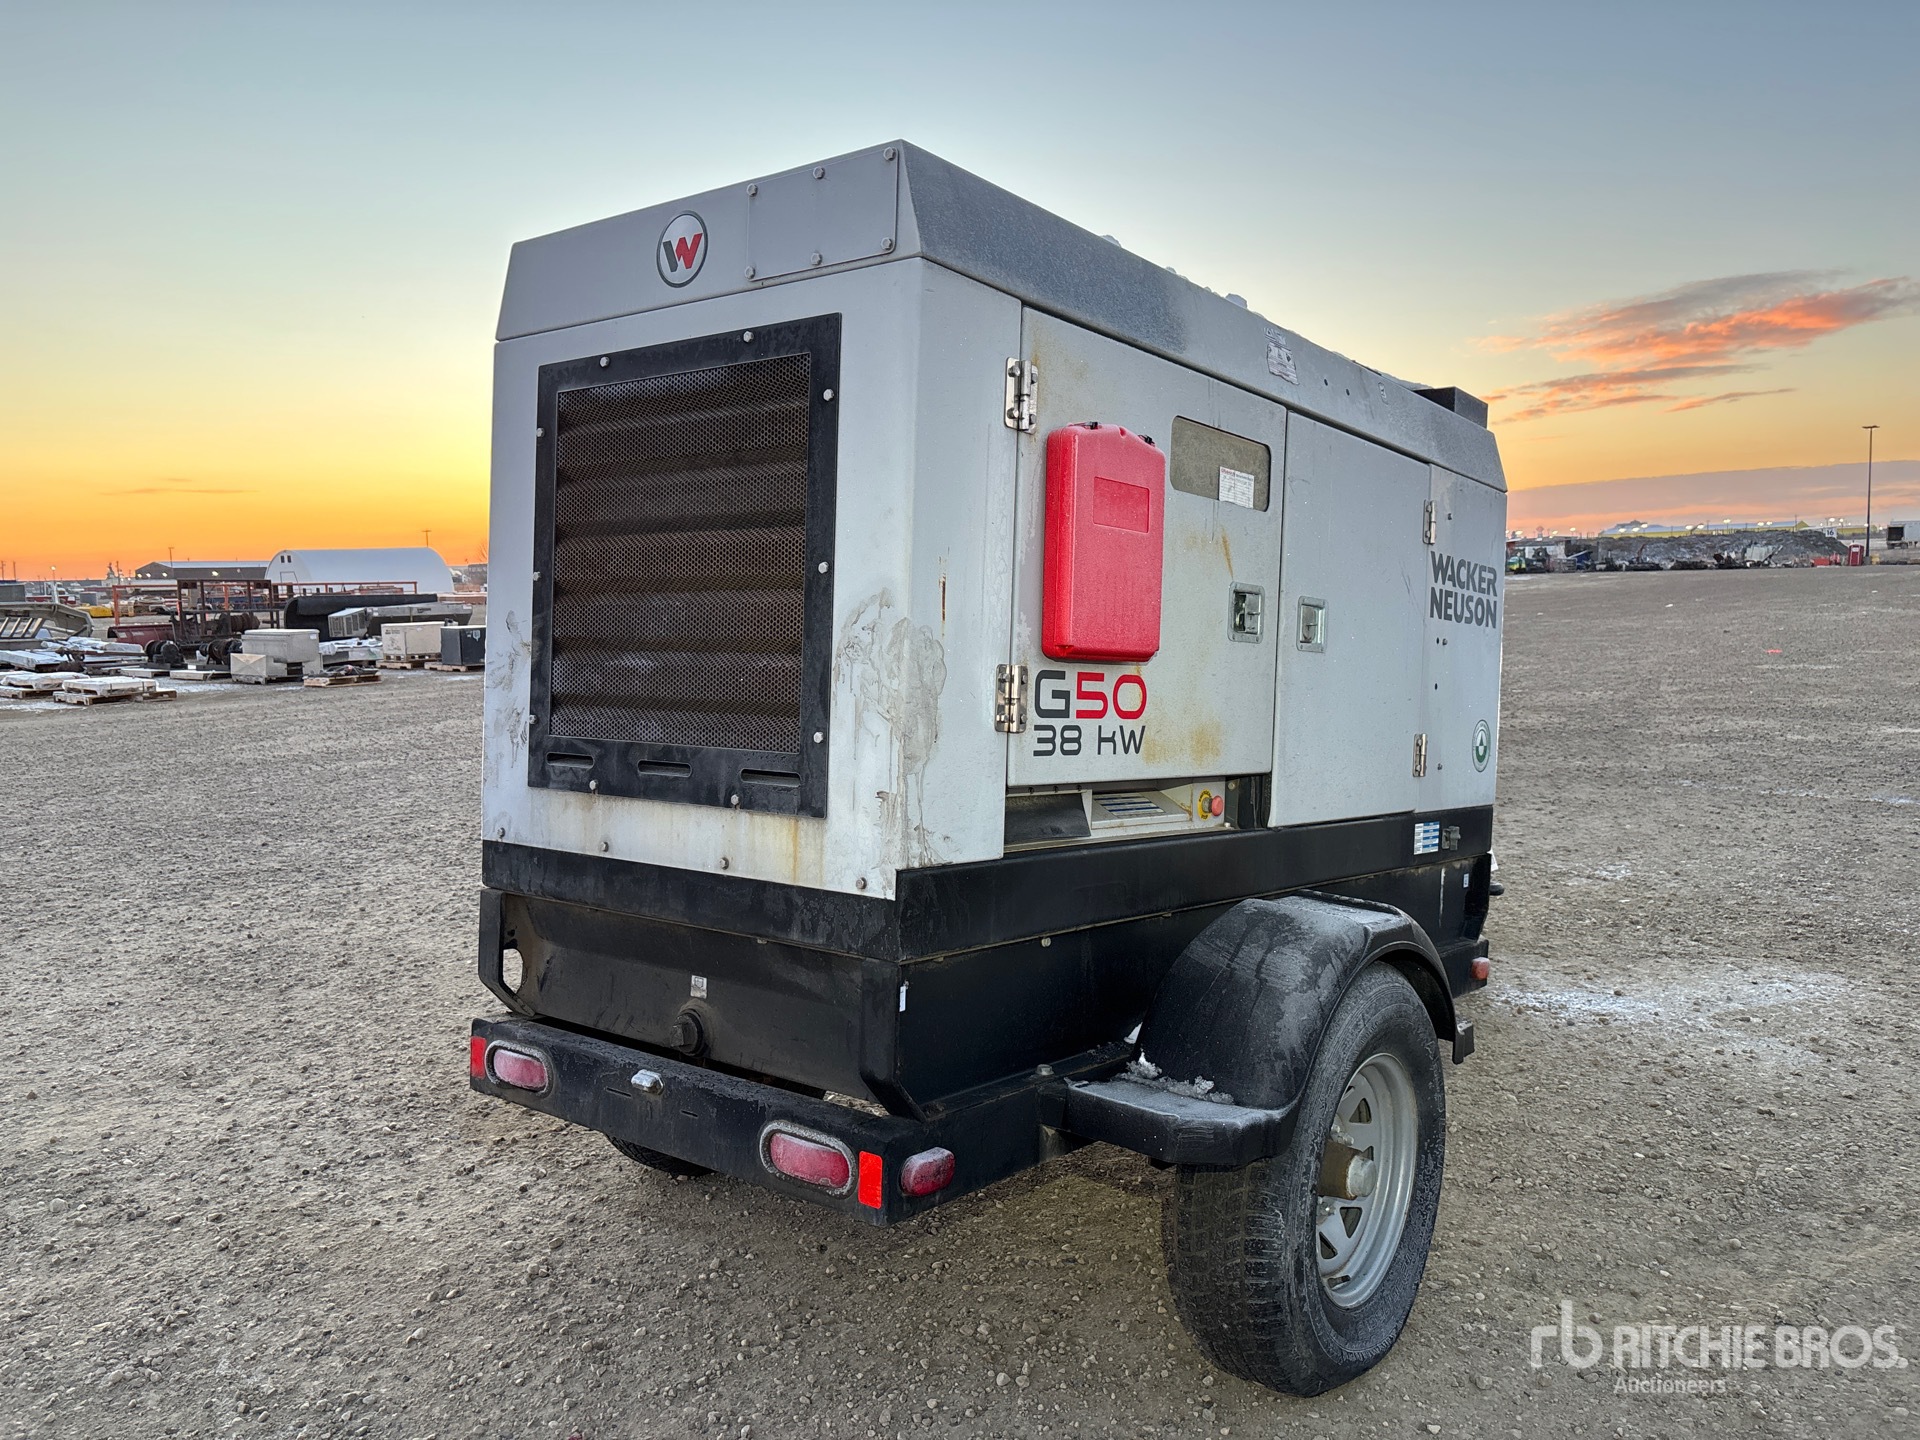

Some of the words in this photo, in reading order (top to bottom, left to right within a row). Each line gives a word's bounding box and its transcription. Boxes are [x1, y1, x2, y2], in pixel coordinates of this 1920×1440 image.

[1430, 550, 1498, 597] WACKER
[1429, 586, 1497, 629] NEUSON
[1034, 669, 1147, 720] G50
[1033, 724, 1082, 757] 38
